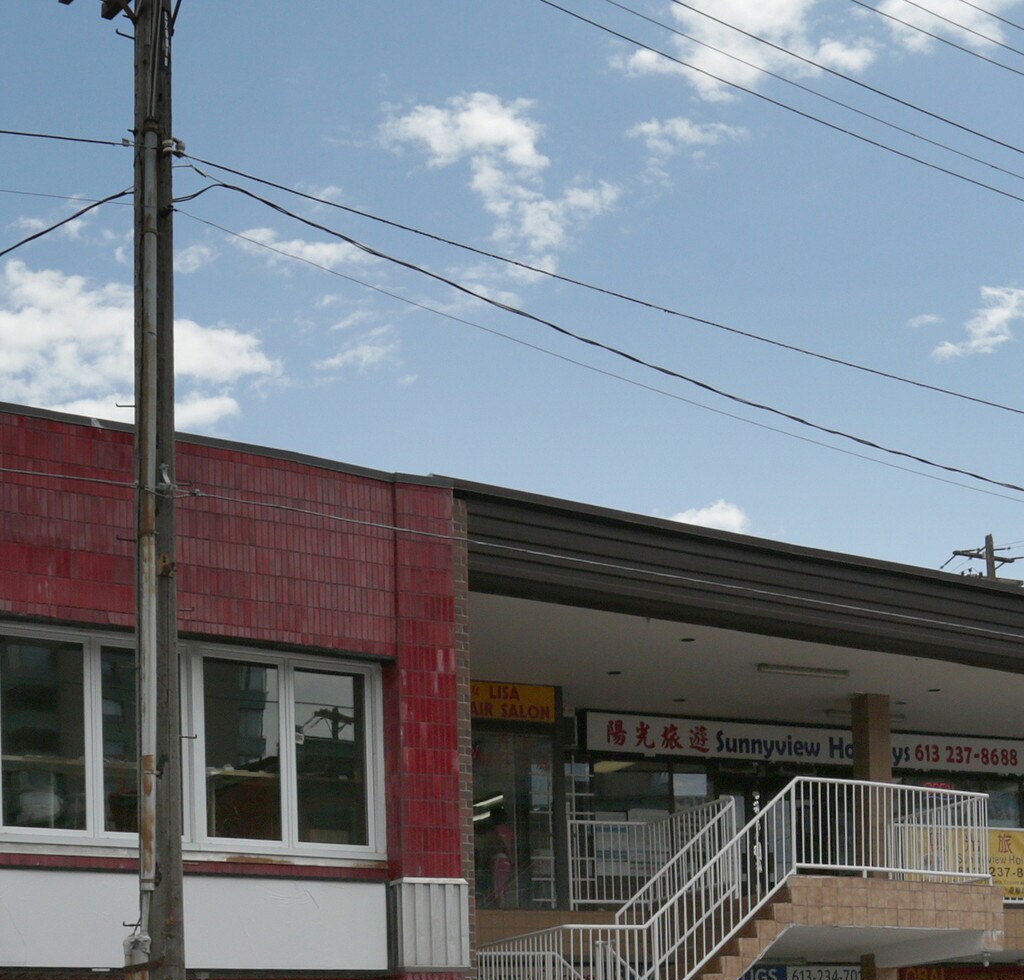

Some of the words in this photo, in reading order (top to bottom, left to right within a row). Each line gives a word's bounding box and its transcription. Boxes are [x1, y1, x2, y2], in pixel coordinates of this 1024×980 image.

[489, 685, 520, 701] LISA
[501, 703, 550, 719] SALON
[606, 719, 710, 753] 陽光旅遊
[716, 730, 821, 758] Sunnyview
[914, 744, 940, 763] 613
[945, 745, 1018, 766] 237-8688
